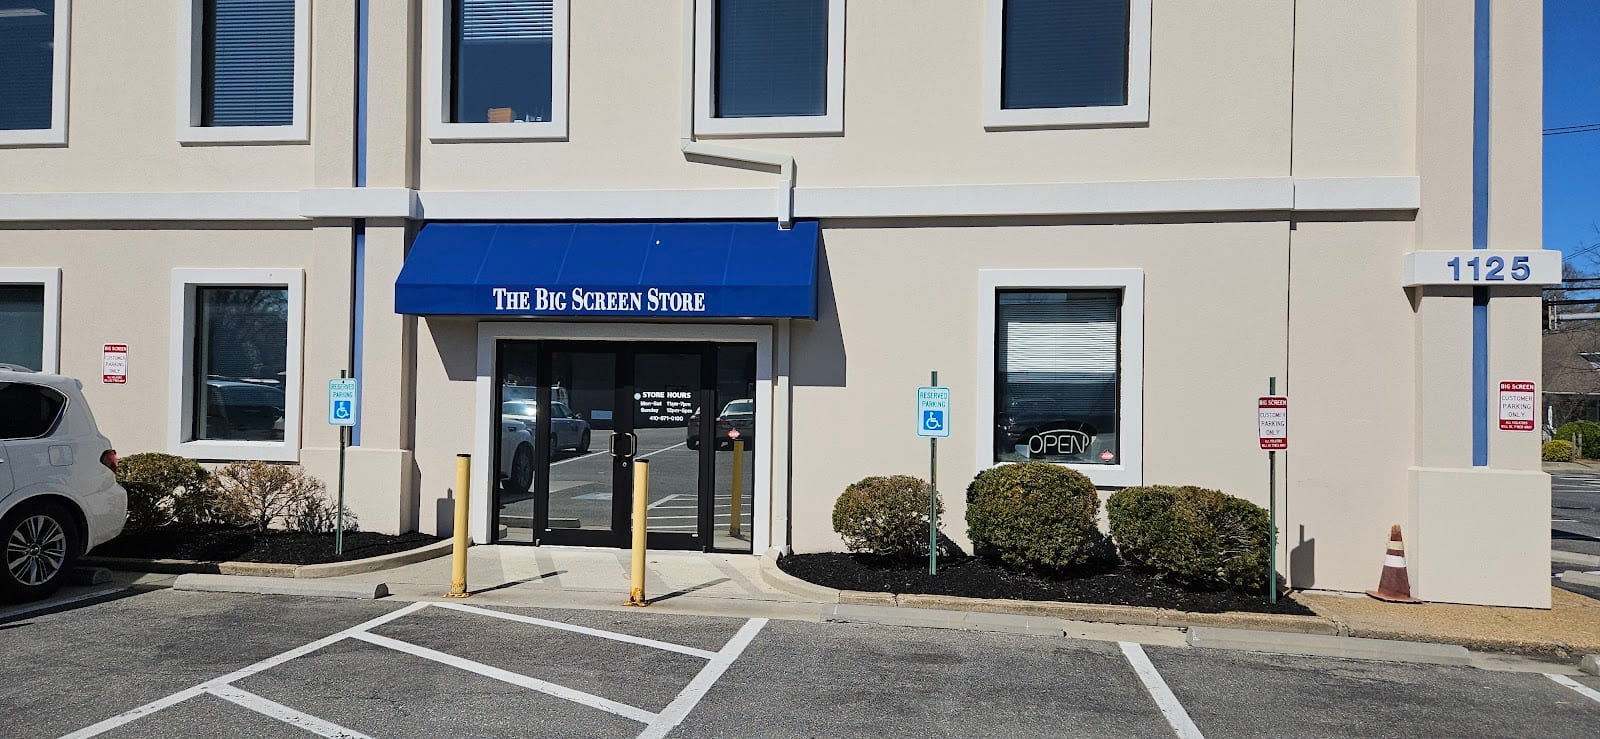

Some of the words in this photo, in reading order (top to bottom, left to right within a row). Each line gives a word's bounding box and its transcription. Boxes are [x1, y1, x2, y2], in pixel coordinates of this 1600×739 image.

[1447, 255, 1531, 281] 1125
[492, 287, 530, 311] THE
[534, 287, 567, 311] BIG
[571, 287, 642, 311] SCREEN
[647, 288, 705, 312] STORE
[642, 391, 665, 399] STORE
[667, 391, 692, 399] HOURS
[1028, 434, 1086, 454] OPEN
